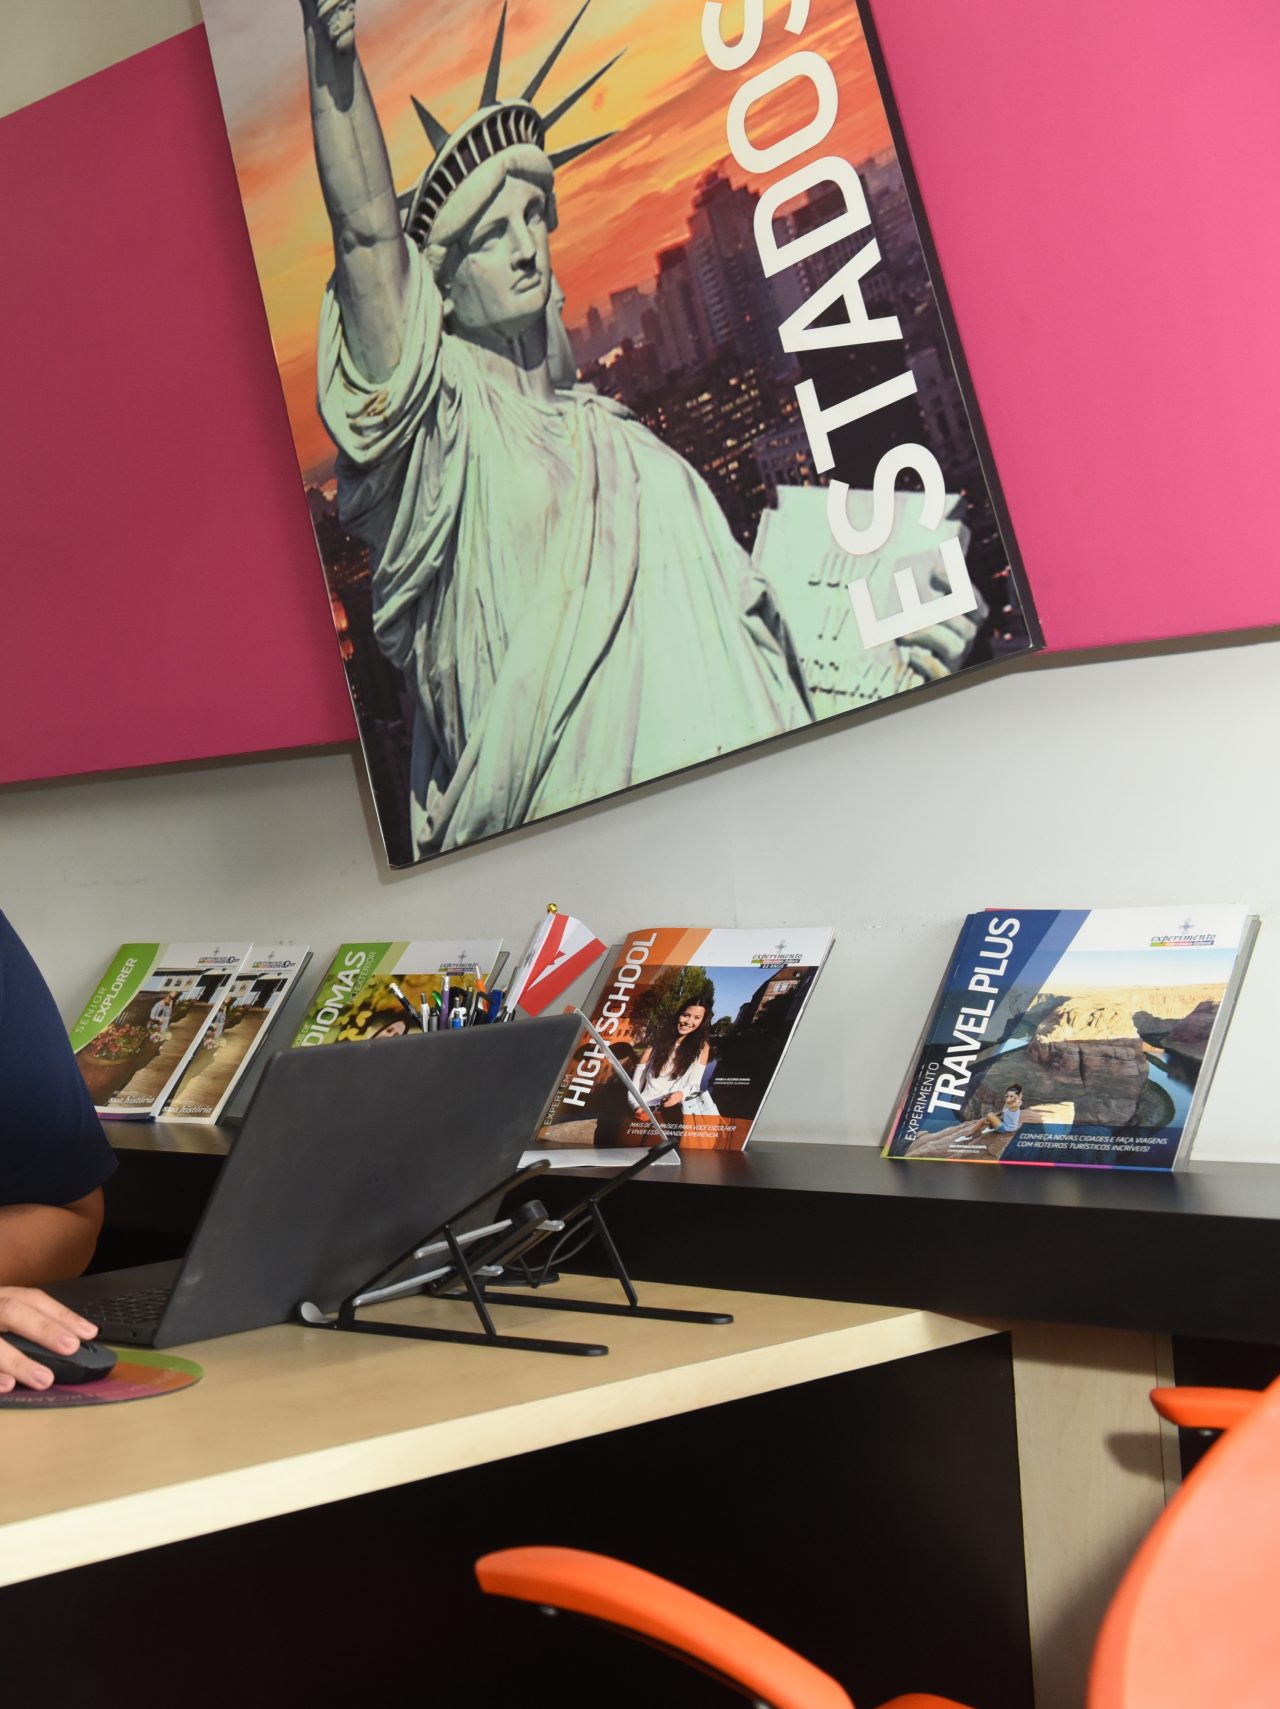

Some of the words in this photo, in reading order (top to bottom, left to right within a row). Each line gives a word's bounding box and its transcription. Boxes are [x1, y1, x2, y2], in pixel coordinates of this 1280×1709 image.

[92, 957, 139, 1023] EXPLORER
[354, 951, 377, 992] EXTERIOR
[75, 986, 108, 1034] SENIOR
[301, 951, 367, 1048] DIOMAS
[562, 1039, 611, 1107] HIGH
[595, 932, 657, 1035] SCHOOL
[927, 999, 996, 1114] TRAVEL
[967, 917, 1021, 995] PLUS
[180, 1104, 212, 1114] história
[543, 1090, 565, 1125] EXPERT
[561, 1074, 573, 1088] EM
[904, 1061, 940, 1141] EXPERIMENTO
[1019, 1133, 1053, 1141] CONHEÇA
[1079, 1135, 1109, 1143] CIDADES
[1069, 1143, 1111, 1151] TURÍSTICOS
